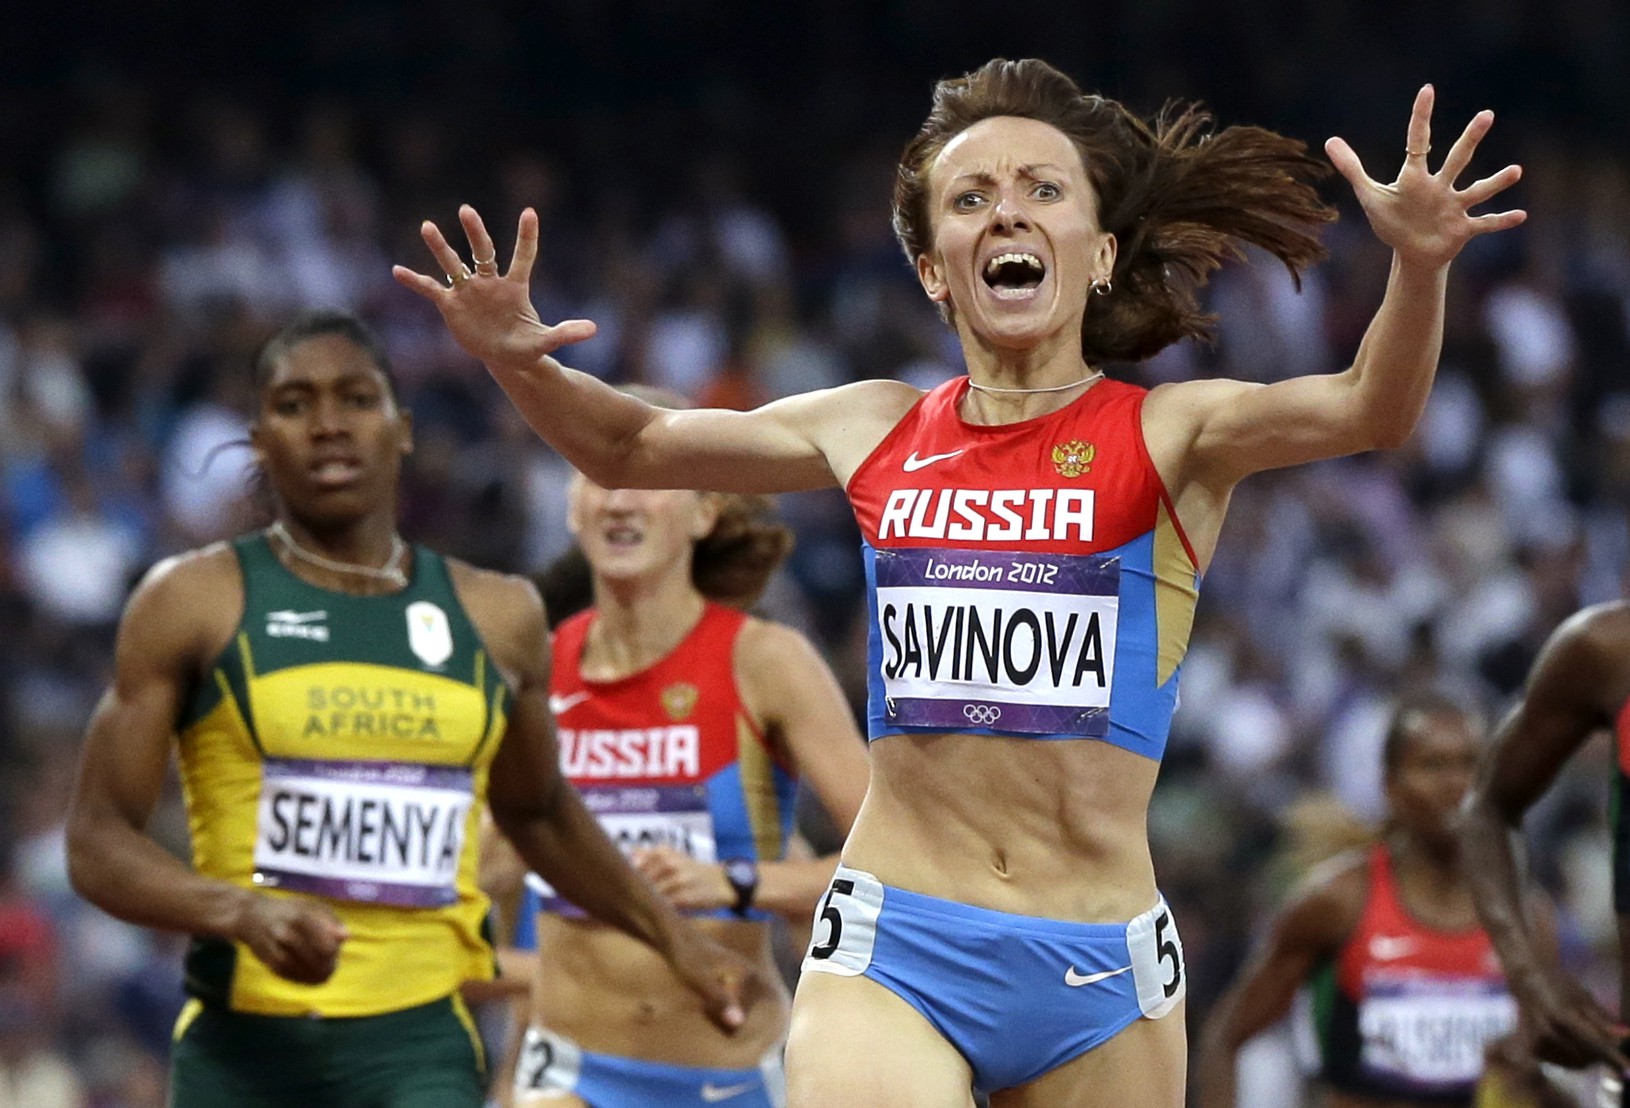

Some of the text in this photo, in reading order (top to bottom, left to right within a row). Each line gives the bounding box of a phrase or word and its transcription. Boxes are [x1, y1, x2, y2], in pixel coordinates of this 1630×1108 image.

[878, 488, 1095, 542] RUSSIA
[925, 558, 1059, 585] London 2012
[883, 602, 1106, 688] SAVINOVA
[303, 713, 440, 738] AFRICA
[308, 686, 436, 711] SOUTH
[558, 725, 699, 778] USSIA
[269, 791, 458, 871] SEMENYA
[811, 878, 854, 960] 5
[1155, 911, 1181, 998] 5
